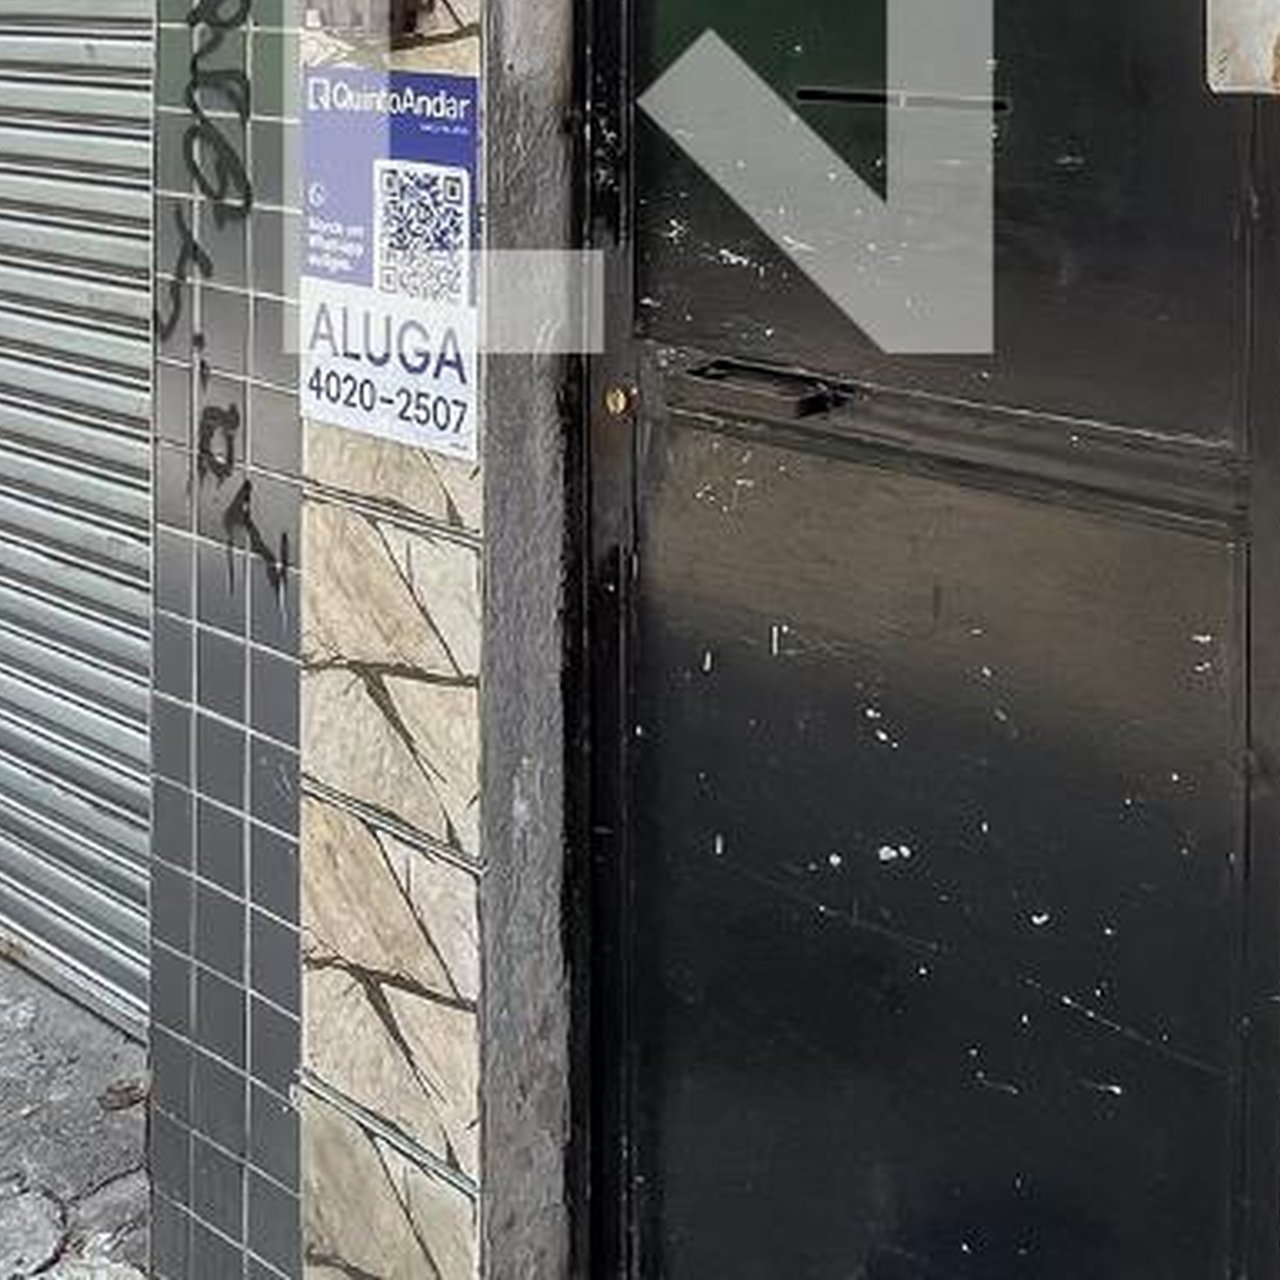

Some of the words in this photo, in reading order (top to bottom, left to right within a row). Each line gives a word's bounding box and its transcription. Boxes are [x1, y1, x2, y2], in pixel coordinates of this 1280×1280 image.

[332, 81, 471, 120] QuintoAndar
[308, 301, 468, 385] ALUGA
[307, 366, 469, 435] 4020-2507
